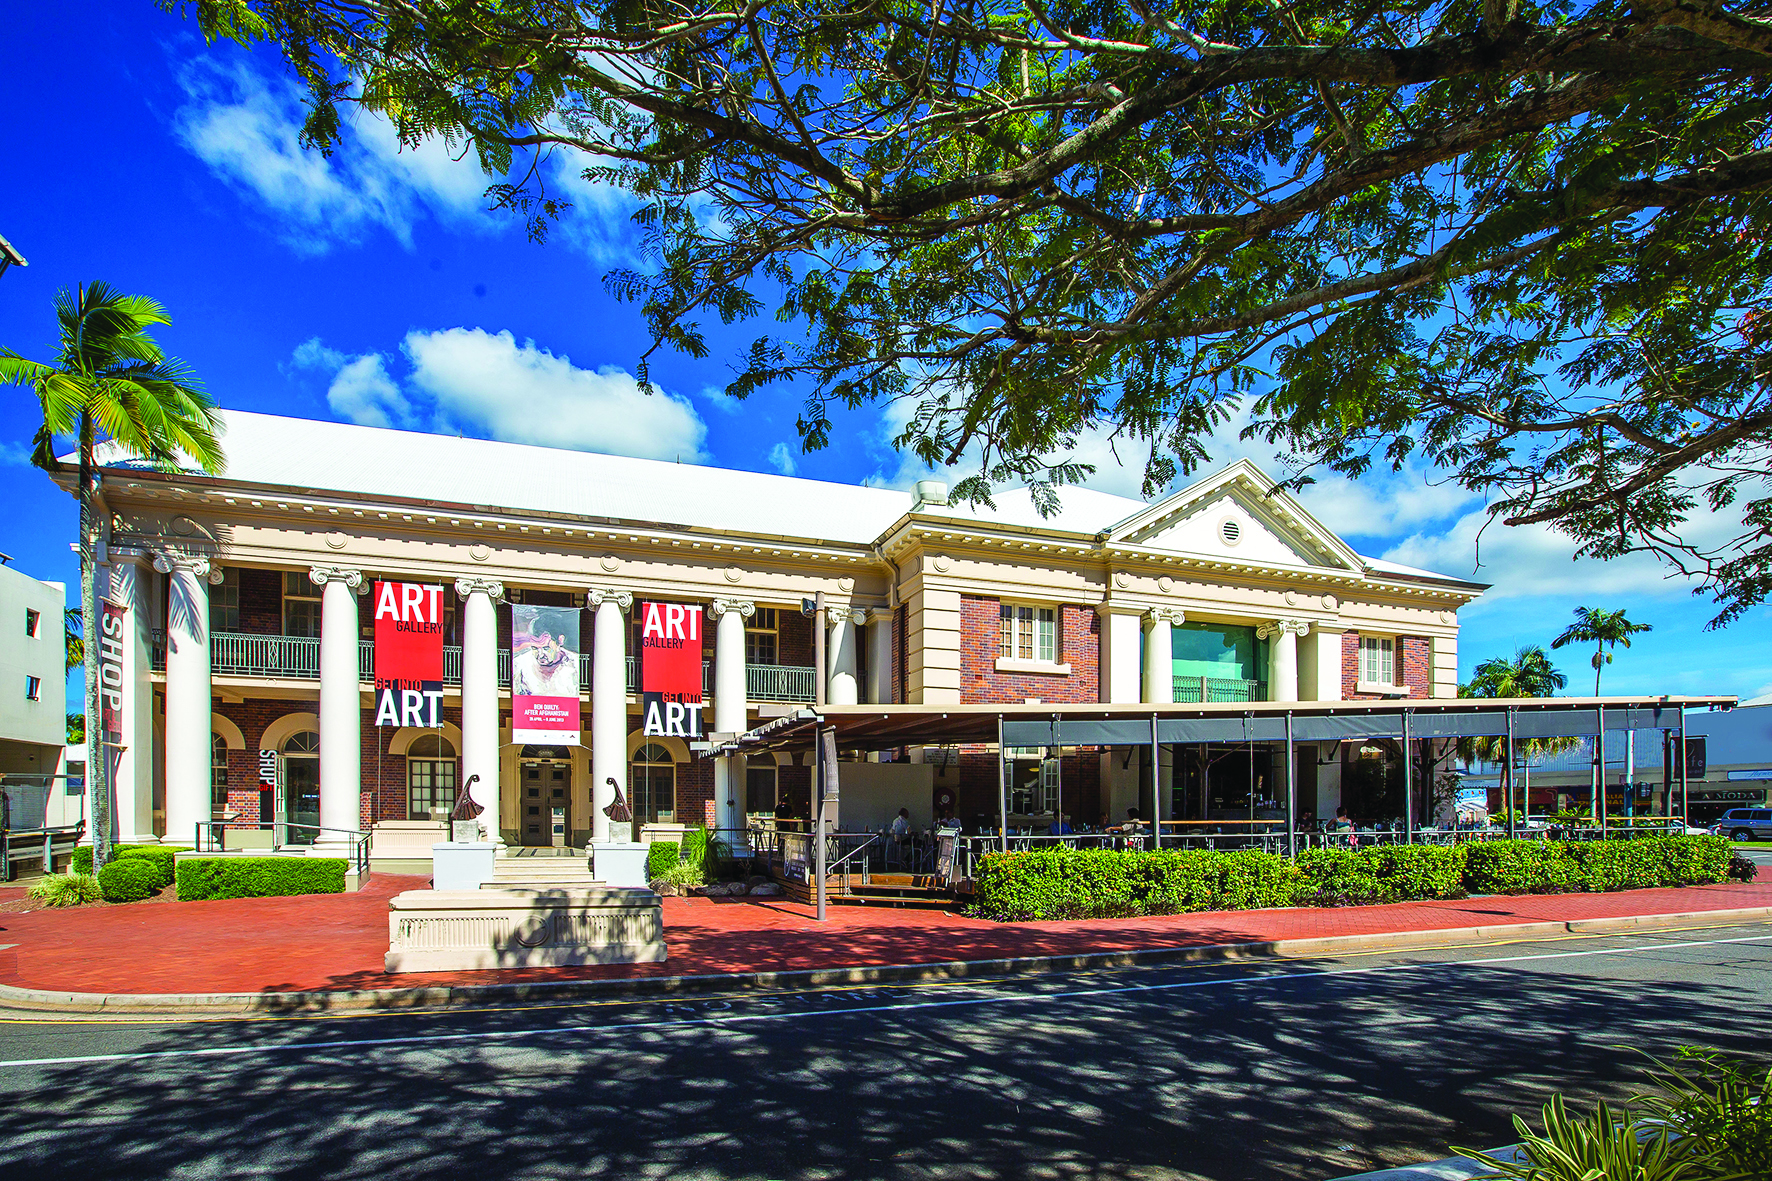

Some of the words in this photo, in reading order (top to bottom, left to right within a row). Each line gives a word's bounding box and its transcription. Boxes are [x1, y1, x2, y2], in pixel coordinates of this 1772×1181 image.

[375, 582, 444, 623] ART
[396, 620, 443, 634] GALLERY
[643, 603, 702, 640] ART
[643, 637, 684, 649] GALLERY
[101, 612, 123, 712] SHOP
[375, 678, 394, 690] GET
[398, 679, 422, 691] INTO
[375, 688, 444, 728] ART
[662, 691, 680, 703] GET
[682, 692, 702, 704] INTO
[643, 701, 703, 737] ART
[1715, 791, 1756, 799] MODA
